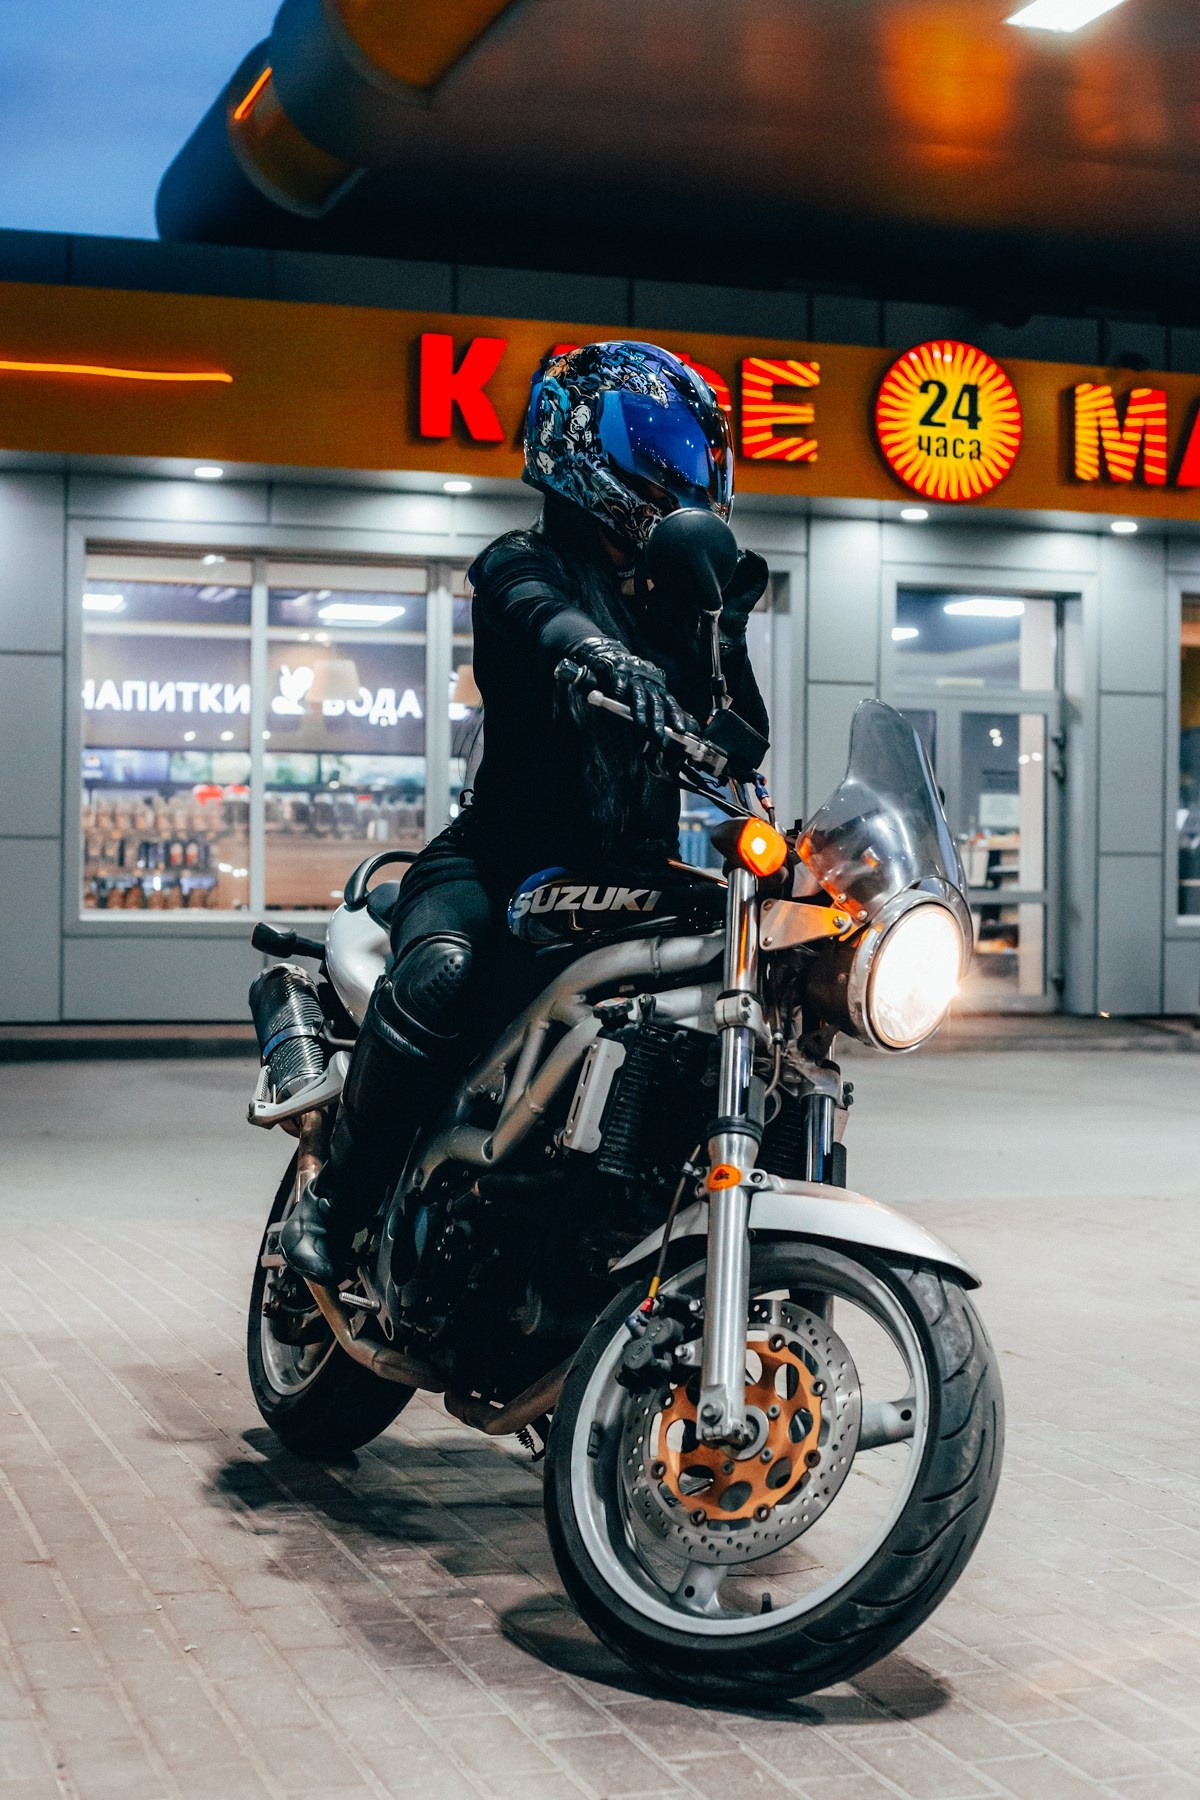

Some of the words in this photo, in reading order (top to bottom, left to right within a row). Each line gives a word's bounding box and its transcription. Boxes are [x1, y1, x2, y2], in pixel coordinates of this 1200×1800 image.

[420, 333, 820, 462] КЕ
[1075, 383, 1200, 486] М
[919, 380, 982, 429] 24
[918, 435, 981, 460] часа
[512, 886, 662, 919] SUZUKI
